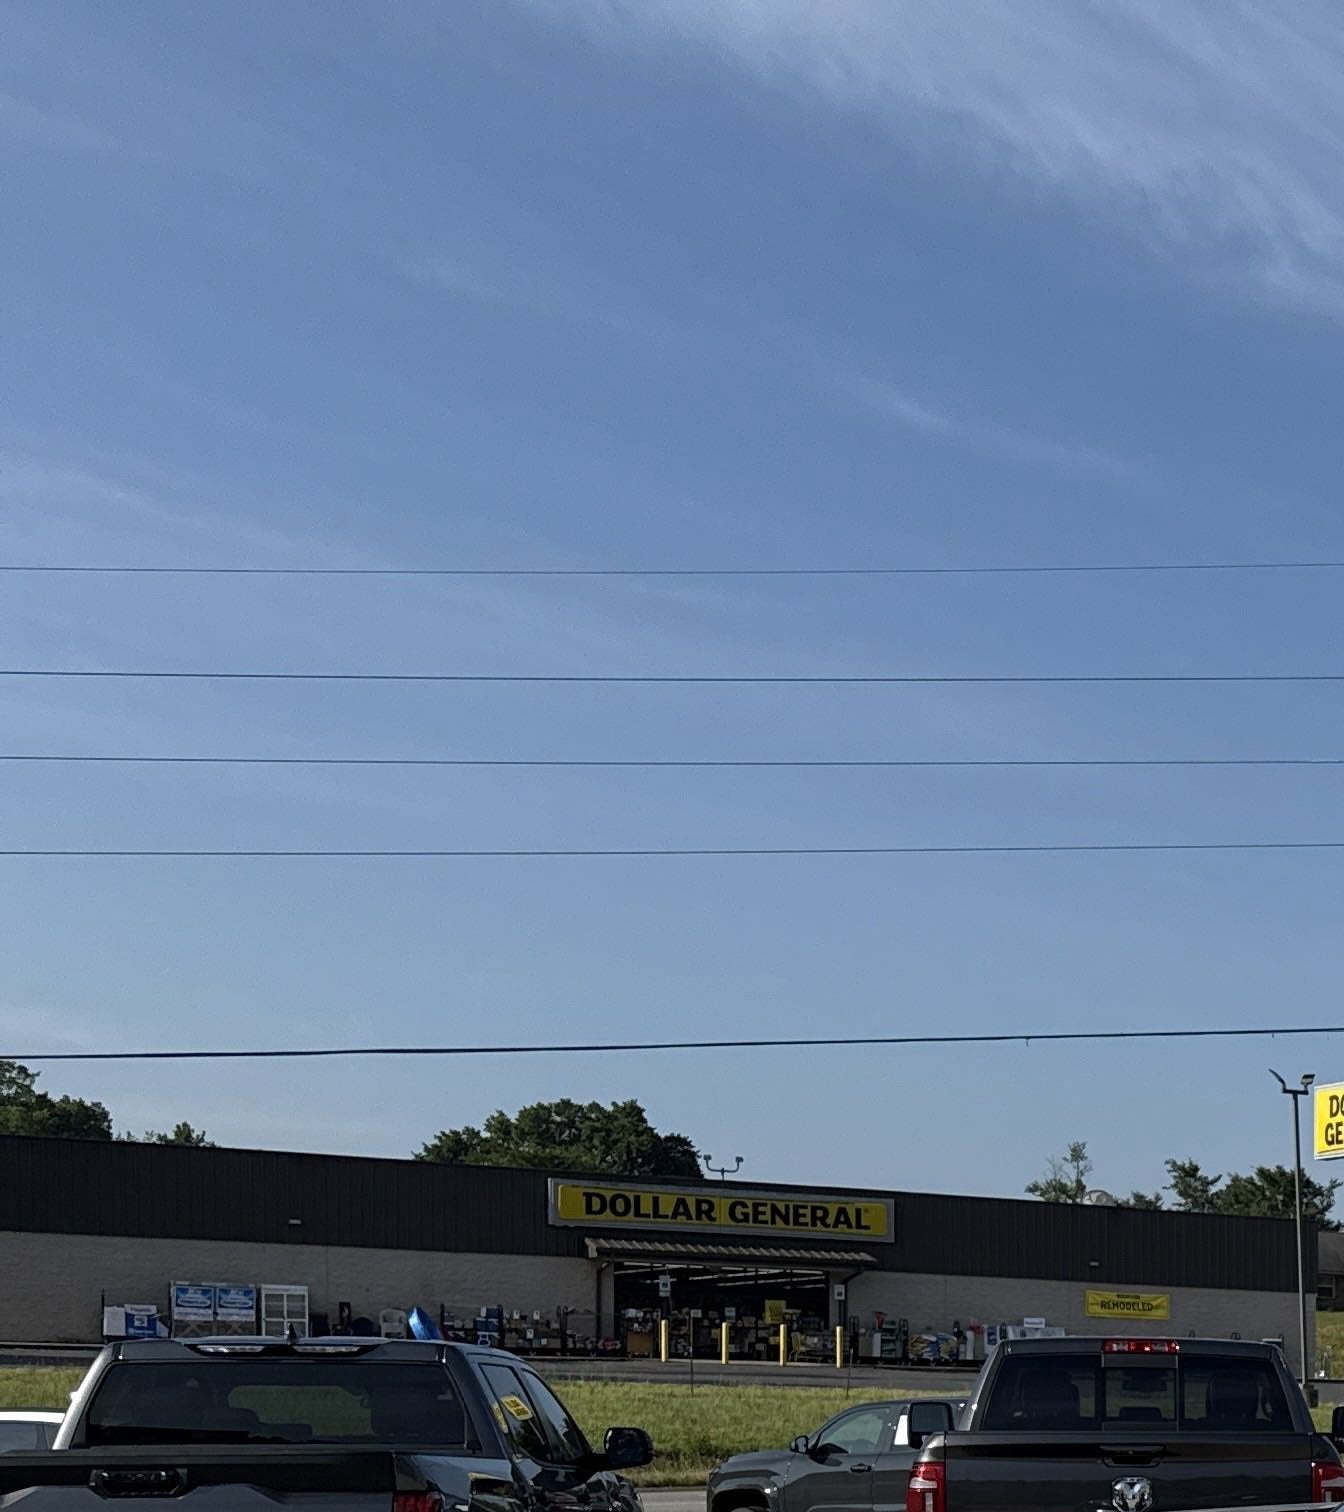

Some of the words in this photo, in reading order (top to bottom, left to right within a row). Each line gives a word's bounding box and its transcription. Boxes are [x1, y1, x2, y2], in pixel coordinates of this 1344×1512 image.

[582, 1191, 717, 1222] DOLLAR
[728, 1200, 871, 1231] GENERAL
[1100, 1299, 1154, 1312] REMODELED
